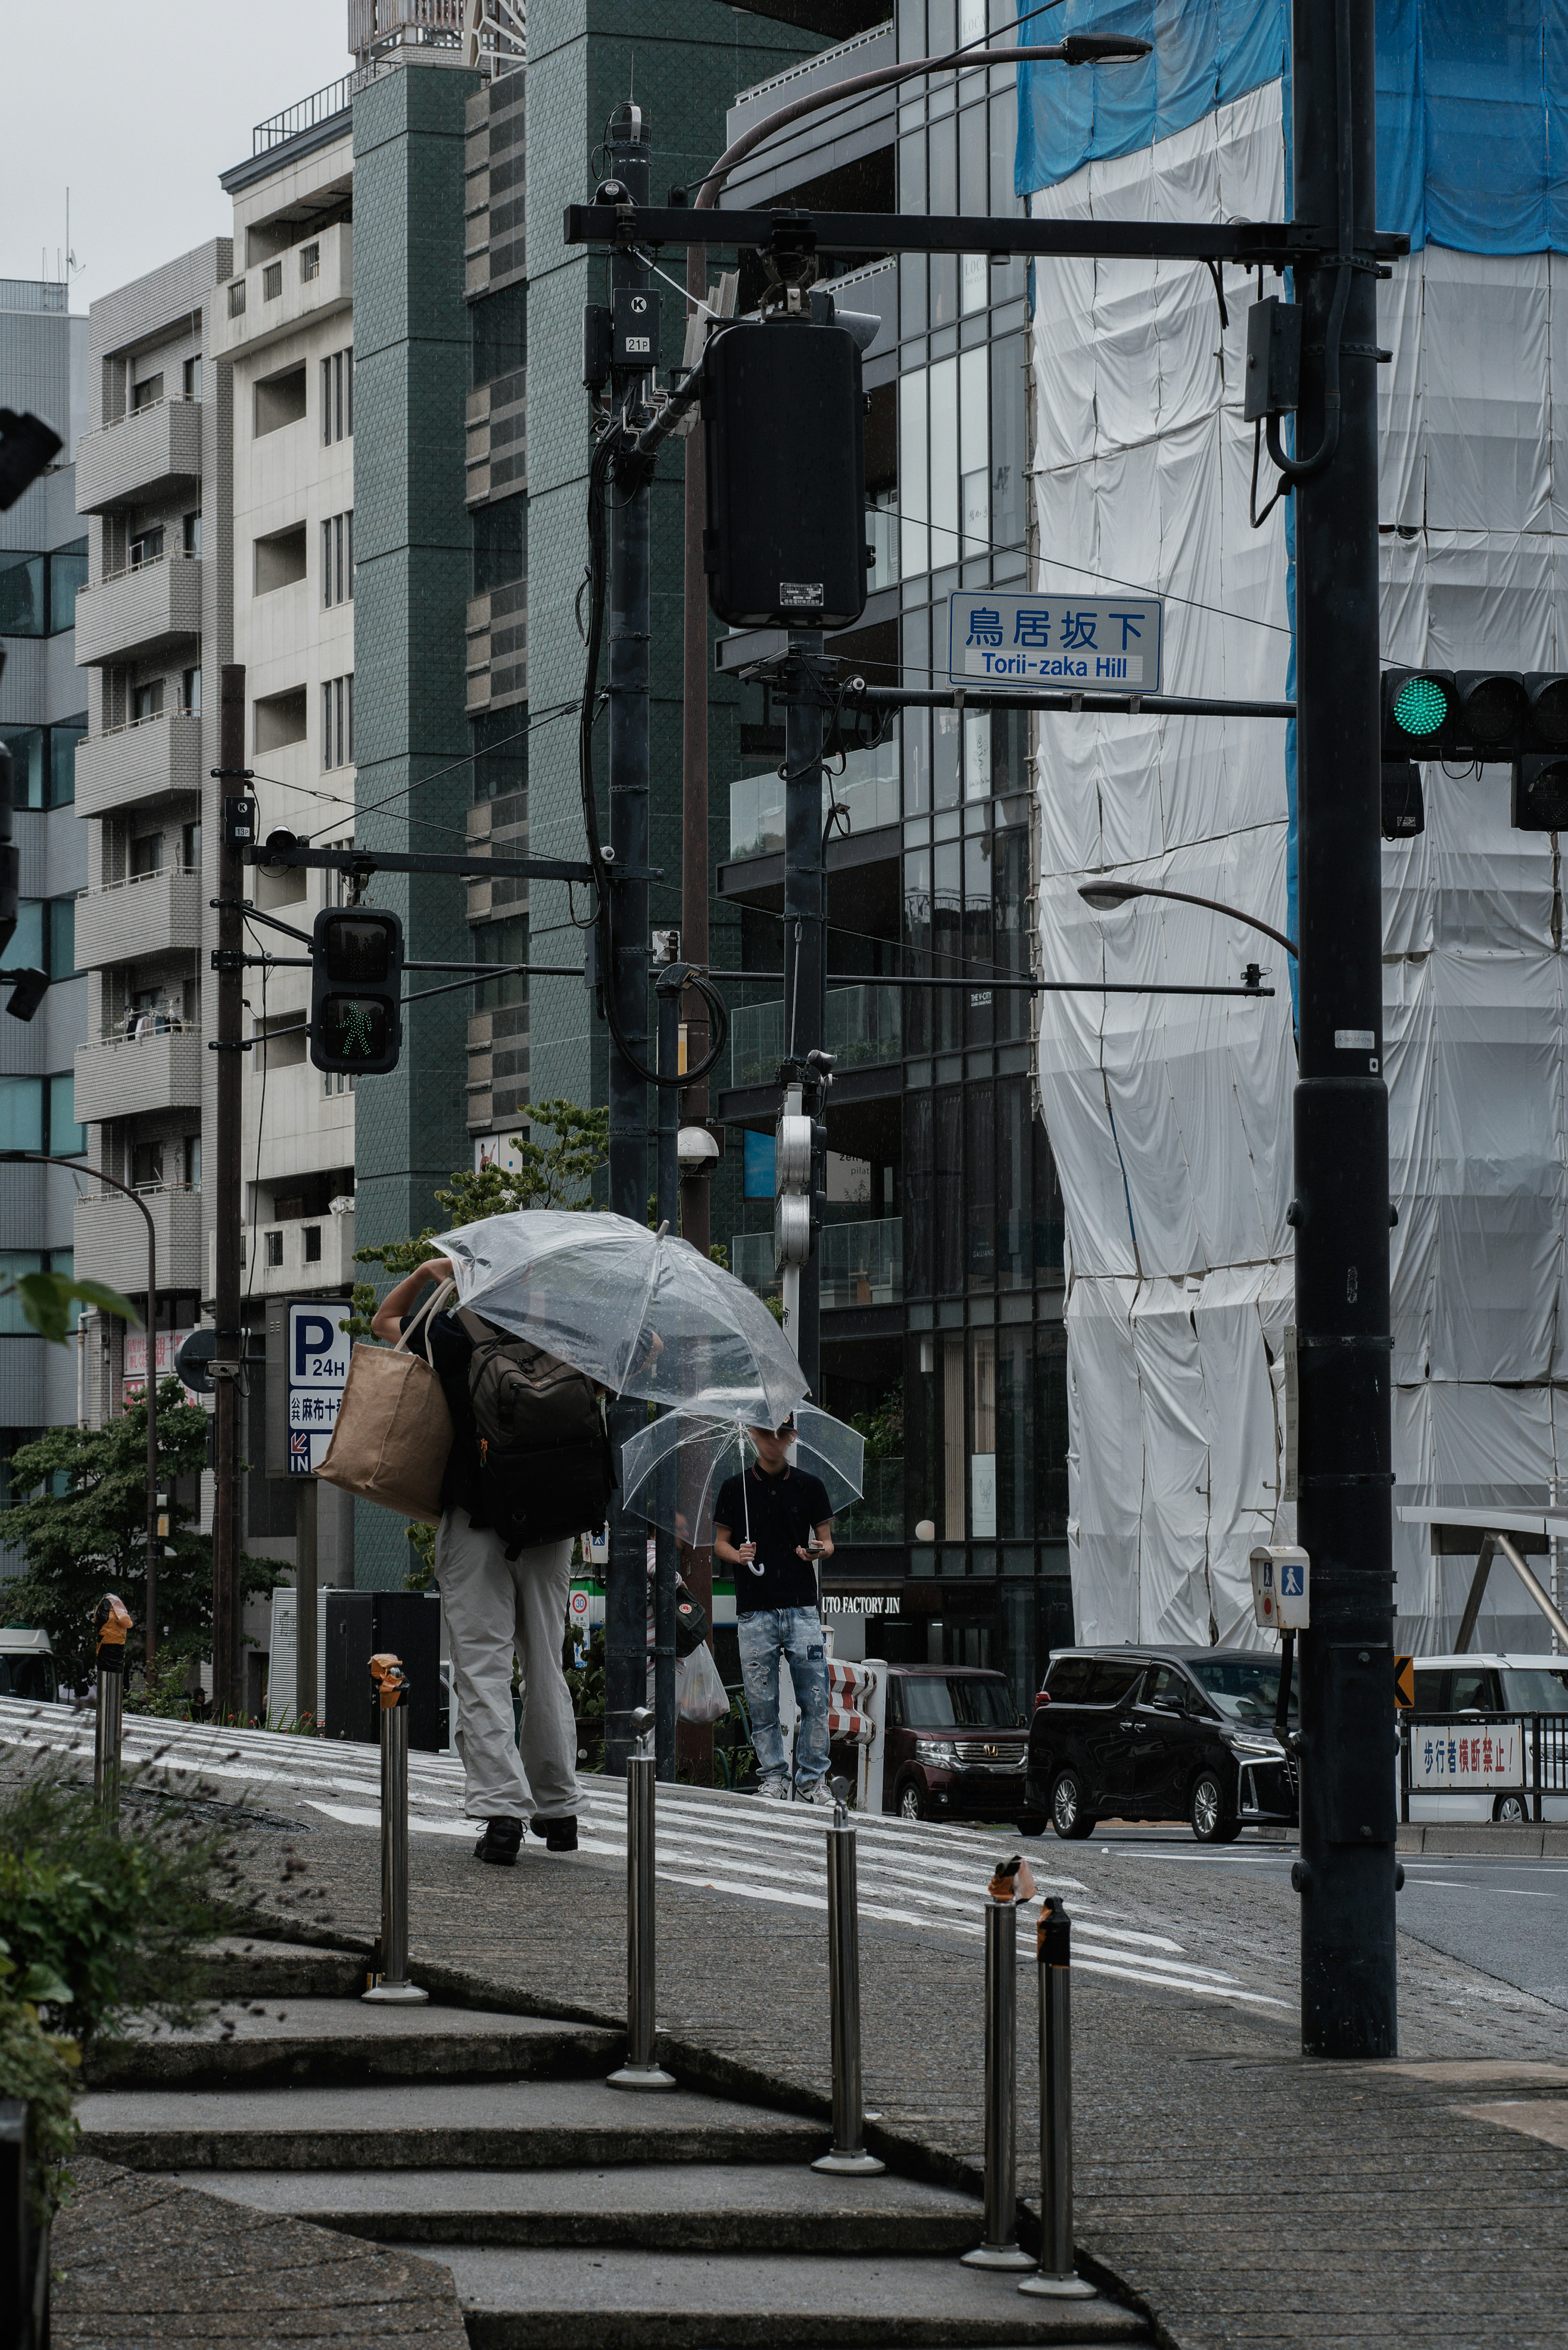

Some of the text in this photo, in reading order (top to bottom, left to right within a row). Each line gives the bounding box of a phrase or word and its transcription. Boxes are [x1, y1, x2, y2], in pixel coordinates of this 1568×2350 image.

[634, 299, 644, 310] K
[629, 339, 648, 350] 21P
[966, 607, 1145, 651] 鳥居坂下
[982, 653, 1127, 678] Torii-zaka Hill
[978, 992, 992, 1000] V-CITY
[296, 1315, 334, 1376] P
[313, 1359, 344, 1376] 24H
[291, 1456, 308, 1472] IN
[576, 1599, 584, 1608] 30
[821, 1596, 900, 1613] UTO FACTORY JIN
